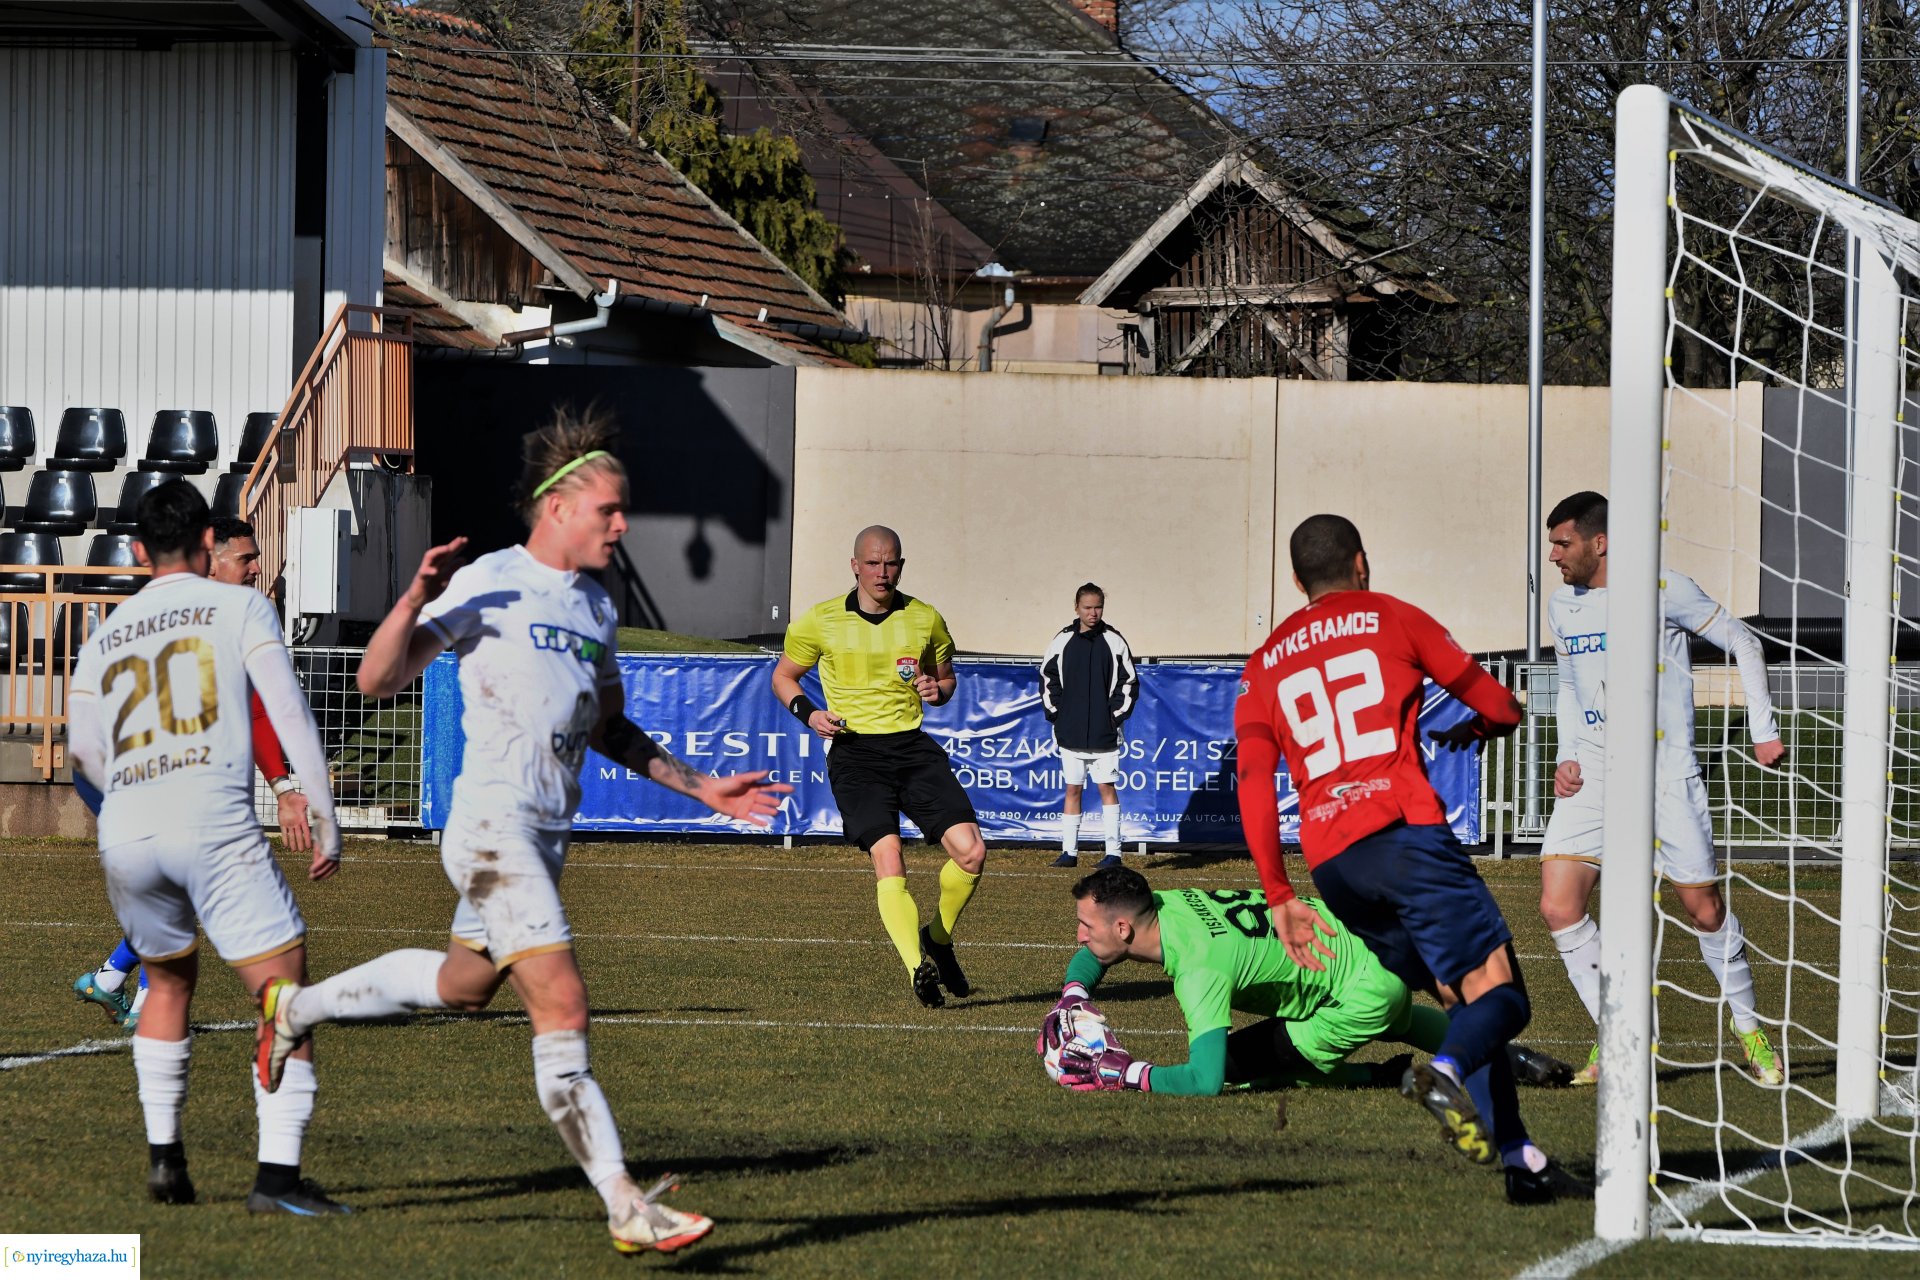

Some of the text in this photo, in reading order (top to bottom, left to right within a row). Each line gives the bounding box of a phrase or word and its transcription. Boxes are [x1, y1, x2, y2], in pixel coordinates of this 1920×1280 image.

[1263, 612, 1380, 670] MYKE RAMOS
[101, 636, 219, 763] 20
[1277, 648, 1397, 781] 92
[943, 738, 972, 757] 45
[1174, 740, 1197, 760] 21
[951, 764, 1019, 791] ÖBB,
[1156, 767, 1220, 791] FÉLE
[979, 811, 996, 820] 512
[1000, 811, 1022, 820] 990
[1155, 813, 1191, 822] LUJZA
[1195, 814, 1226, 823] UTCA
